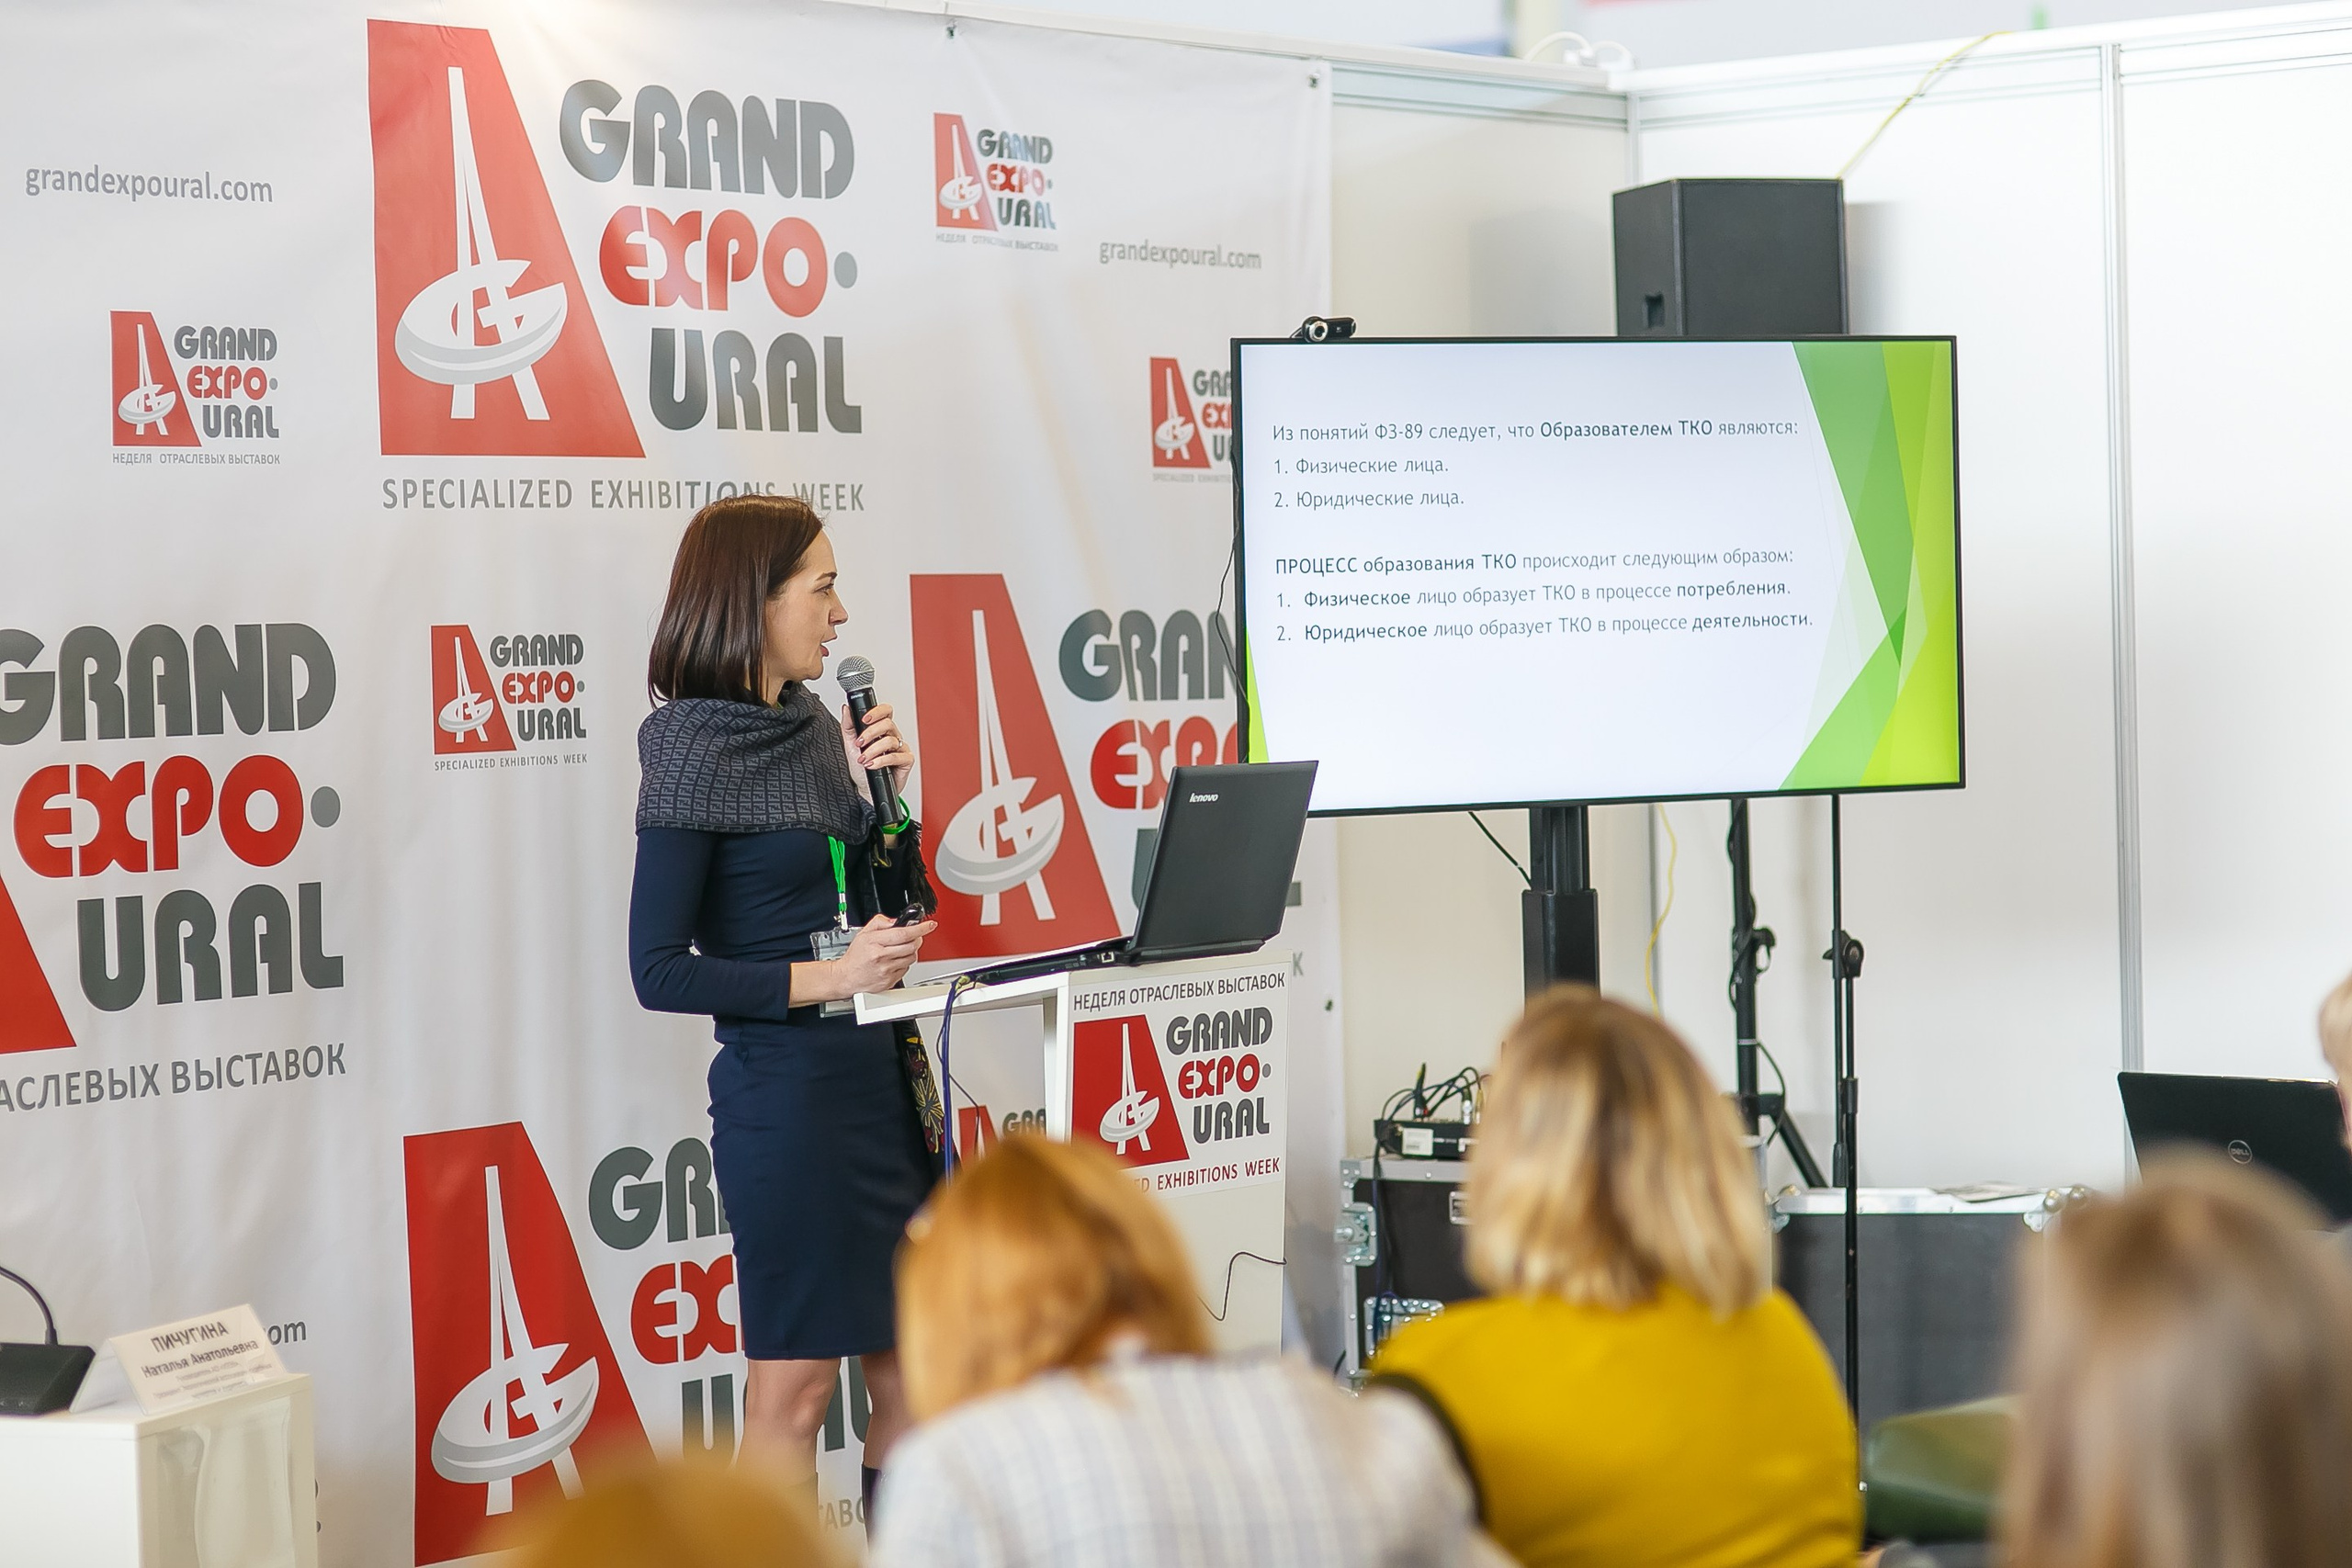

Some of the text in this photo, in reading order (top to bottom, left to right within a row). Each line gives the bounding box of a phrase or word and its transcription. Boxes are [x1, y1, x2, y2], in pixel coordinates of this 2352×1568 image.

[560, 79, 854, 199] GRAND
[977, 129, 1053, 164] GRAND
[26, 164, 273, 202] grandexpoural.com
[998, 197, 1057, 230] URAL
[599, 206, 828, 317] EXPO
[1100, 239, 1261, 268] grandexpoural.com
[174, 325, 277, 361] GRAND
[187, 365, 267, 400] EXPO
[650, 327, 862, 434] URAL
[203, 404, 279, 438] URAL
[1273, 420, 1798, 442] Из понятий ФЗ-89 следует, что Образователем ТКО являются:
[112, 453, 280, 466] НЕДЕЛЯ ОТРАСЛЕВЫХ ВЫСТАВОК
[1274, 458, 1448, 475] 1. Физические лица.
[382, 479, 572, 510] SPECIALIZED
[793, 482, 865, 511] WEEK
[1274, 491, 1464, 511] 2. Юридические лица.
[1276, 548, 1793, 577] ПРОЦЕСС образования ТКО происходит следующим образом:
[1277, 581, 1791, 607] 1. Физическое лицо образует ТКО в процессе потребления.
[1277, 614, 1813, 643] 2. Юридическое лицо образует ТКО в процессе деятельности.
[490, 634, 583, 668] GRAND
[0, 622, 336, 746] GRAND
[502, 671, 575, 704] EXPO
[517, 707, 586, 741] URAL
[435, 753, 588, 771] SPECIALIZED EXHIBITIONS WEEK
[1090, 716, 1237, 809] EXP
[1189, 793, 1218, 802] lenovo
[15, 754, 304, 878] EXPO
[76, 882, 344, 1011] URAL
[1074, 972, 1285, 1012] НЕДЕЛЯ ОТРАСЛЕВЫХ ВЫСТАВОК
[1166, 1006, 1273, 1055] GRAND
[171, 1043, 345, 1094] ВЫСТАВОК
[1178, 1054, 1261, 1099] EXPO
[1193, 1097, 1270, 1144] URAL
[1158, 1164, 1238, 1190] EXHIBITIONS
[1245, 1157, 1280, 1177] WEEK
[589, 1137, 732, 1250] GR
[630, 1254, 745, 1365] EX
[150, 1321, 230, 1353] ПИЧУГИНА
[141, 1358, 189, 1378] Наталья
[190, 1338, 259, 1365] Анатольевна
